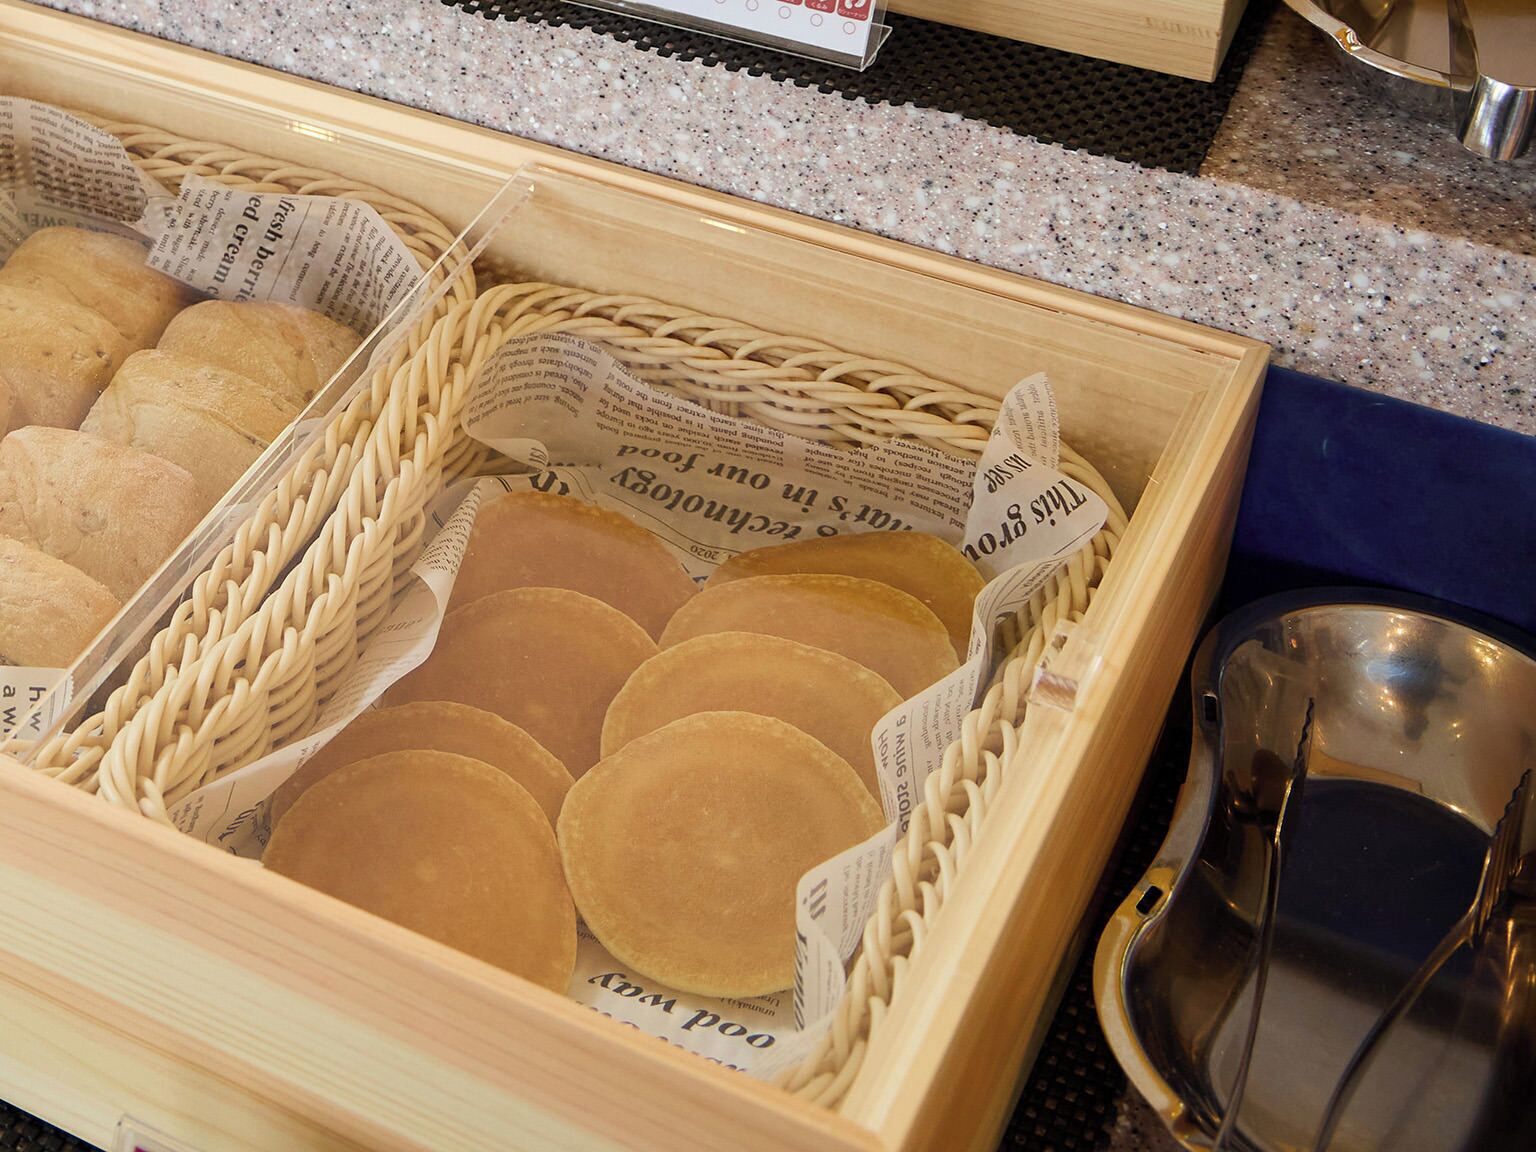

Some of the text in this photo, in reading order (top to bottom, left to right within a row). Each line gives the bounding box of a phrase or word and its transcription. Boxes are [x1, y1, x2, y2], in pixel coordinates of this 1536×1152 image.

[31, 125, 45, 135] This
[204, 189, 219, 210] berry
[166, 217, 177, 230] so,
[263, 199, 296, 244] fresh
[156, 233, 171, 253] until
[168, 211, 196, 255] with sugar
[195, 207, 226, 262] dessert made
[211, 222, 251, 284] cream
[306, 239, 320, 258] being
[333, 244, 347, 265] extend
[379, 244, 395, 264] attack
[150, 255, 160, 267] the
[381, 253, 403, 283] provided
[288, 261, 310, 301] consumed
[330, 261, 354, 301] The selection
[315, 280, 331, 304] season
[576, 339, 585, 350] B
[539, 344, 597, 367] nutrients such
[537, 354, 594, 379] carbohydrates
[543, 369, 568, 383] bread
[523, 381, 556, 391] counting
[568, 376, 588, 393] Also,
[602, 383, 625, 403] during
[615, 378, 633, 394] roots
[533, 392, 578, 418] Serving size
[626, 399, 643, 411] that
[635, 389, 648, 401] the
[650, 396, 672, 410] from
[645, 406, 681, 423] possible
[676, 404, 706, 419] extract
[709, 415, 736, 428] starch
[595, 407, 679, 439] years ago Europe
[598, 397, 783, 455] revealed starch residue on rocks used for
[708, 423, 737, 437] plants.
[740, 421, 764, 434] time,
[741, 431, 784, 447] pounding
[768, 429, 784, 439] this
[847, 446, 868, 459] high
[882, 447, 964, 476] aeration methods
[804, 446, 959, 493] occurring microbes (for example
[835, 462, 849, 472] the
[852, 467, 874, 478] from
[893, 458, 931, 473] recipes)
[980, 449, 1032, 494] us see
[615, 441, 818, 514] in our food
[877, 472, 913, 487] ranging
[848, 474, 959, 514] Bread may leavened
[858, 483, 888, 498] breads
[916, 483, 960, 503] processes
[606, 462, 803, 548] technology
[909, 499, 944, 519] textures
[1027, 473, 1087, 533] This
[949, 517, 965, 530] and
[689, 543, 719, 561] 2020
[2, 684, 16, 697] a
[586, 966, 677, 1015] way
[680, 1004, 777, 1052] ood
